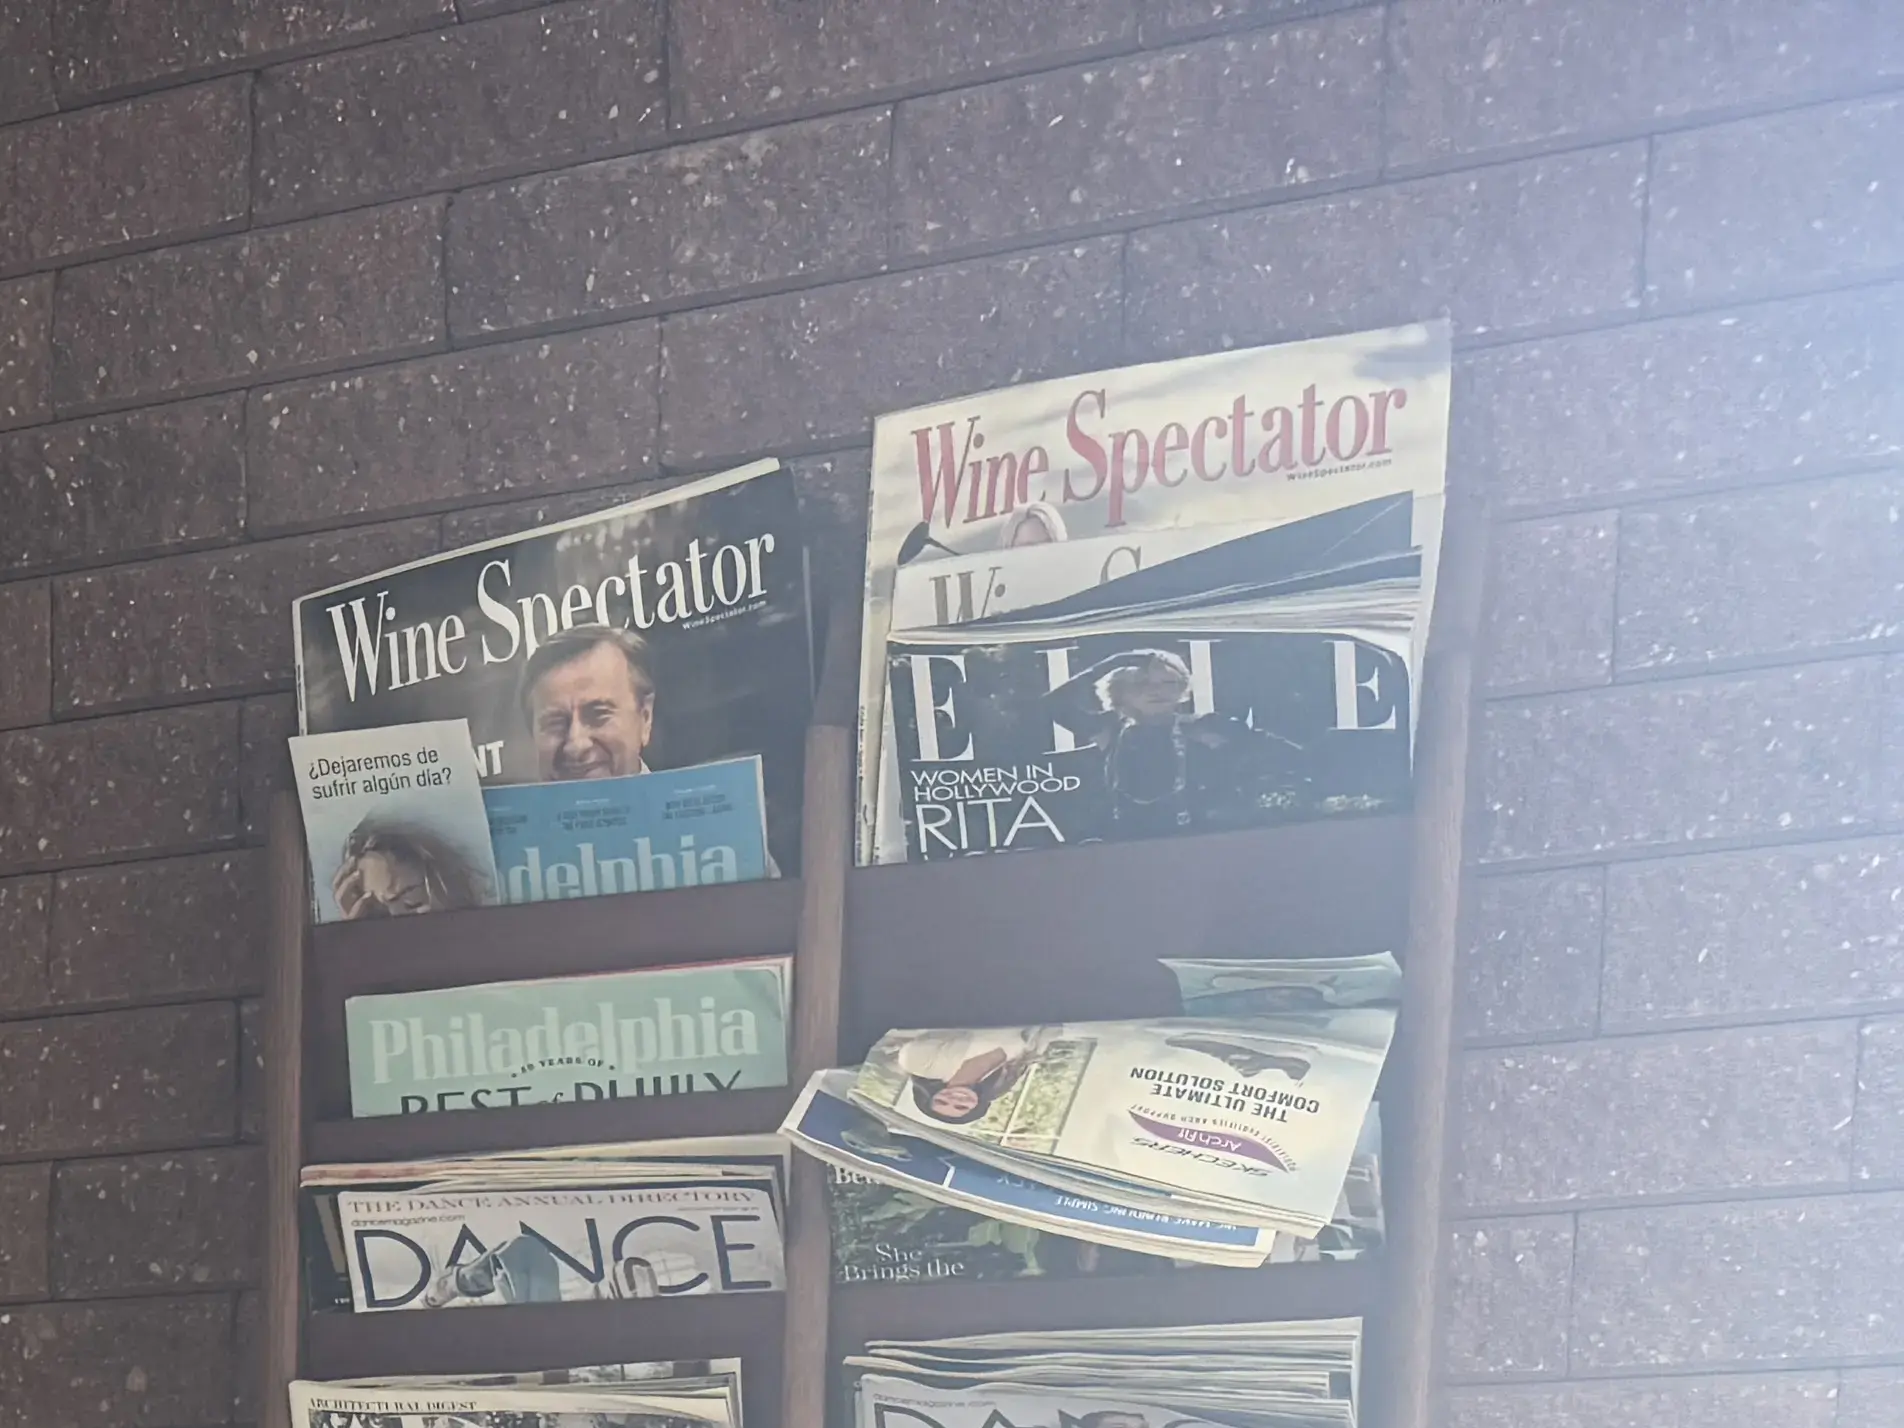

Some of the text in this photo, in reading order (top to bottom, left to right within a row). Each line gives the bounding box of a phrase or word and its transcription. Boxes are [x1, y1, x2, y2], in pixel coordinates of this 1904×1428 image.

[910, 388, 1407, 529] Wine Spectator
[326, 532, 774, 701] Wine Spectator
[308, 747, 439, 780] ¿Dejaremos de
[912, 763, 1053, 787] WOMEN IN
[311, 766, 452, 801] sufrir algún día?
[915, 776, 1081, 801] HOLLYWOOD
[915, 796, 1064, 854] RITA
[369, 996, 760, 1084] Philadelphia
[1130, 1068, 1319, 1113] COMFORT SOLUTION
[1151, 1084, 1287, 1122] THE ULTIMATE
[1131, 1137, 1272, 1177] SKECHERS
[348, 1189, 755, 1214] THE DANCE ANNUAL DIRECTORY
[354, 1215, 772, 1309] DANCE
[845, 1258, 964, 1282] Brings the
[875, 1242, 922, 1262] She
[310, 1398, 477, 1411] ARCHITECTURAL DIGEST
